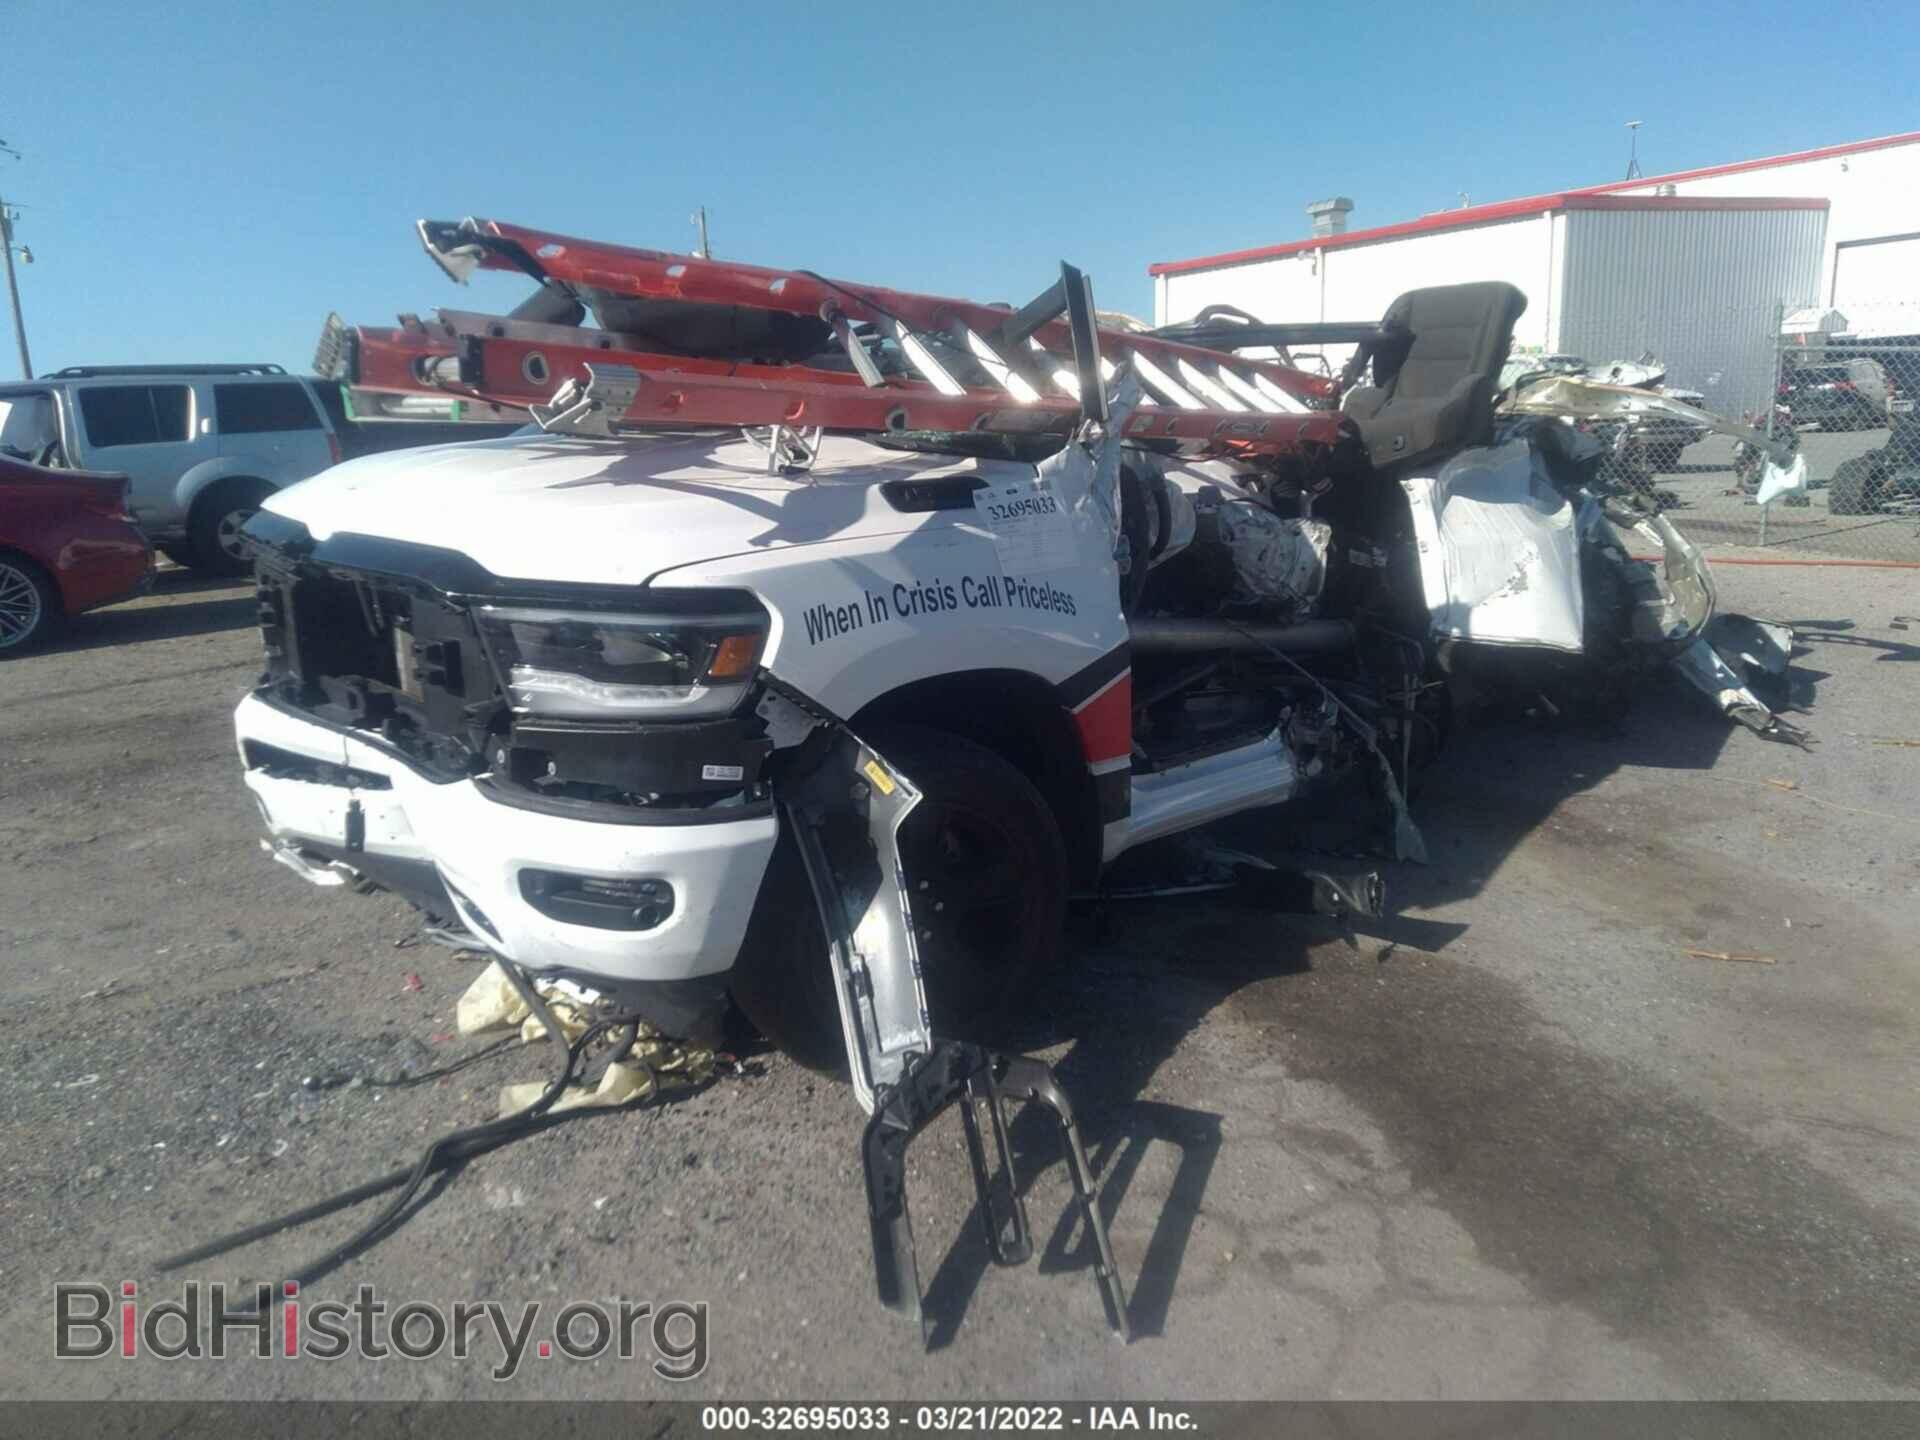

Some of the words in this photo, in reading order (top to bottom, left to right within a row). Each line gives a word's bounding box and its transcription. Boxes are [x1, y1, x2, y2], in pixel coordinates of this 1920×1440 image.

[987, 496, 1057, 520] 32695033
[803, 599, 863, 645] When
[864, 590, 889, 624] In
[892, 578, 958, 617] Crisis
[961, 576, 1002, 608] Call
[1003, 576, 1077, 616] Priceless
